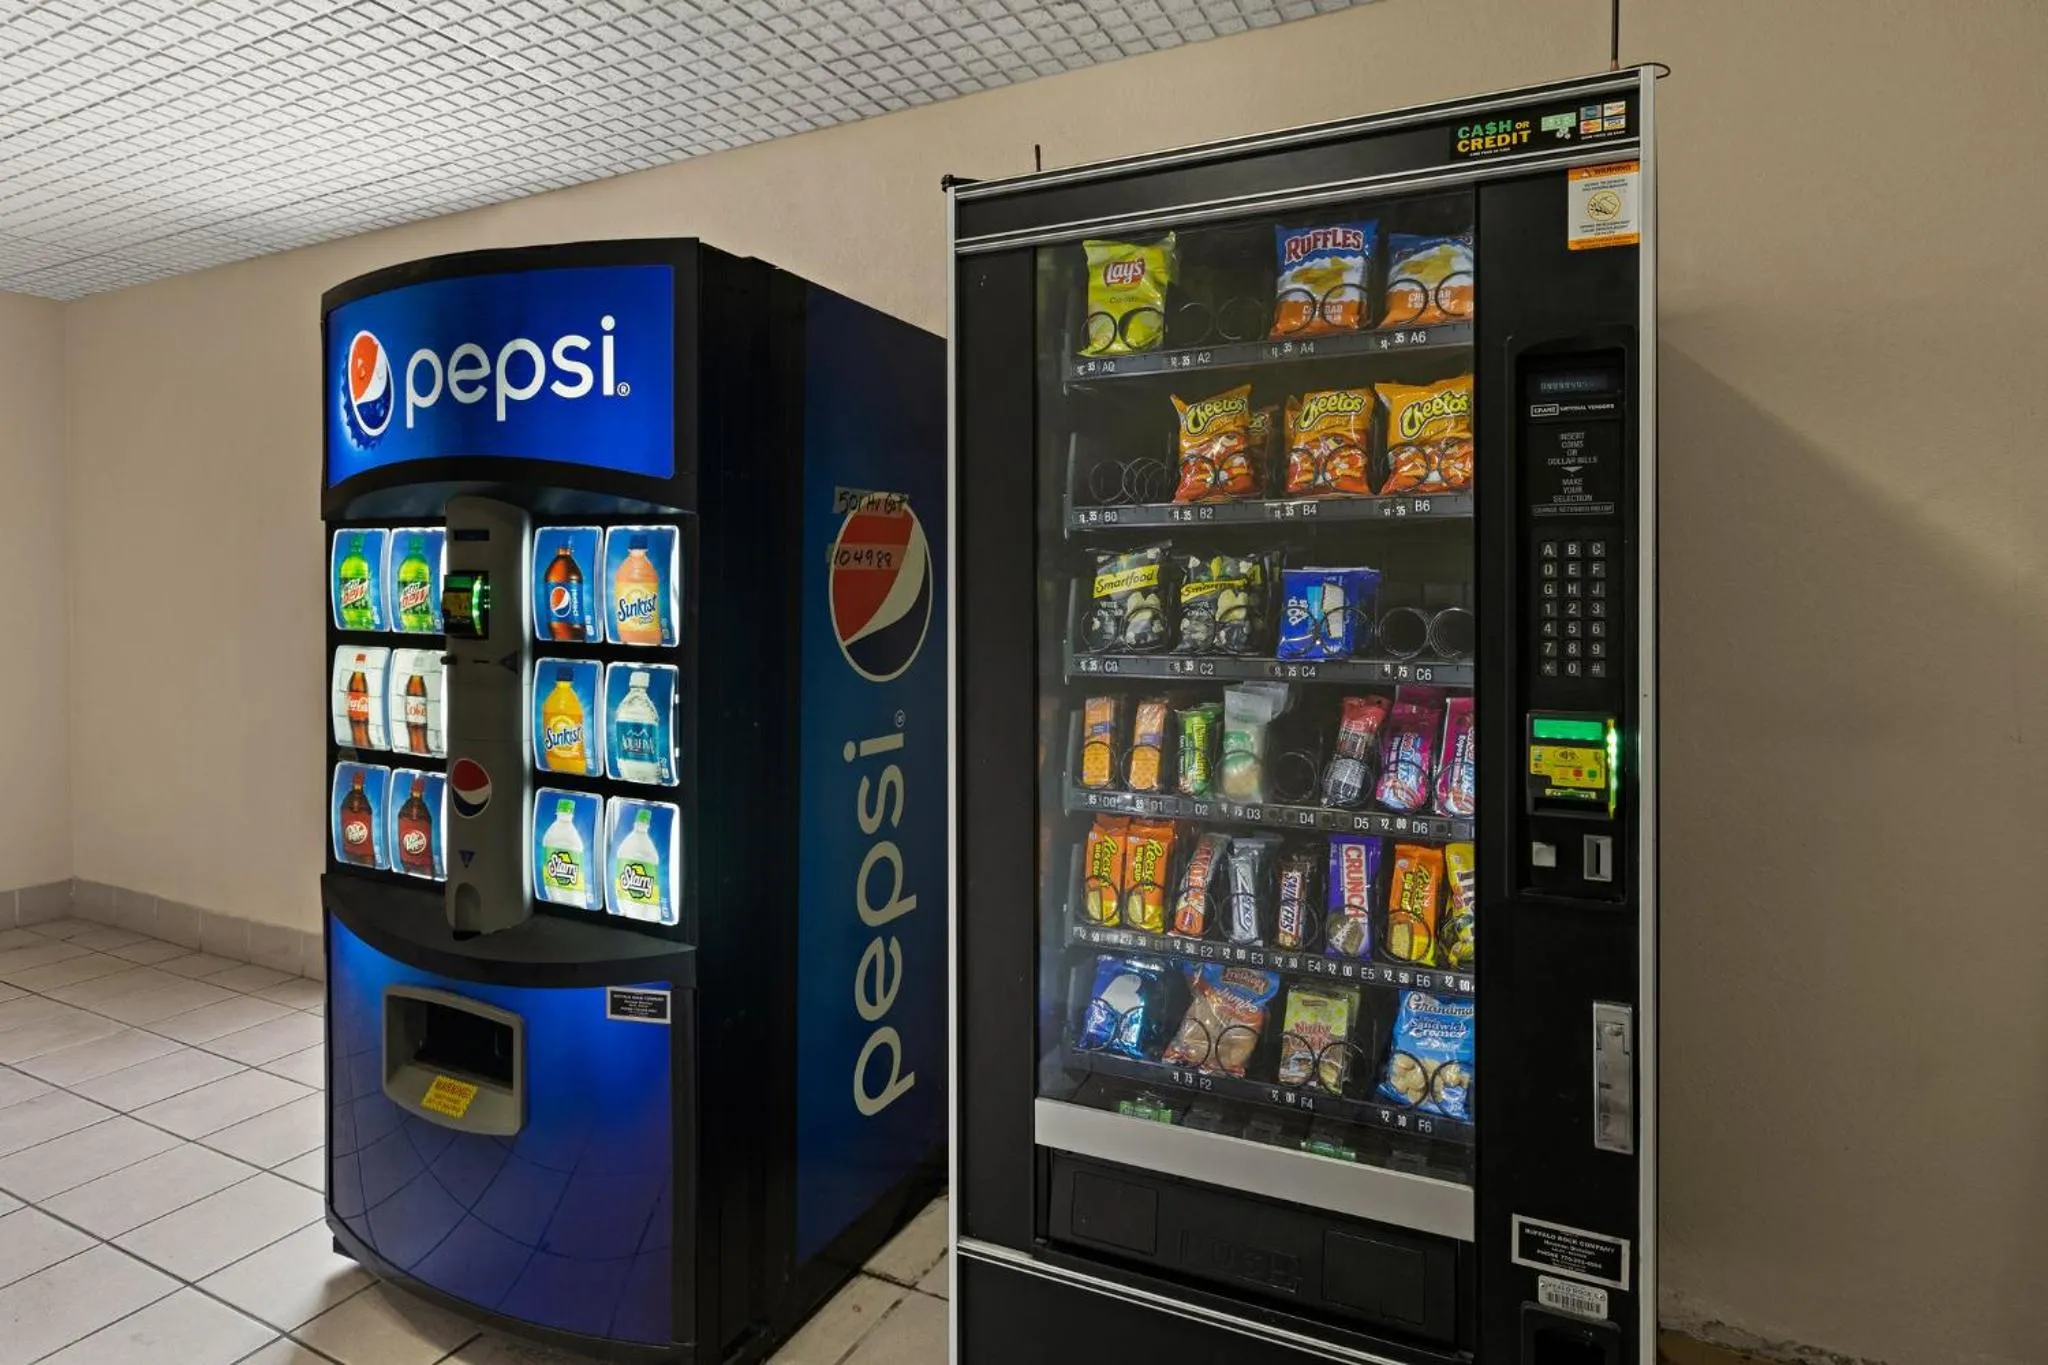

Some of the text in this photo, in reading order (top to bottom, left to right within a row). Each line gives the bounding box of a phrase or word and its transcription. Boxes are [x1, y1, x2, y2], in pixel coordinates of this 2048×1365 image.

[1515, 121, 1531, 130] OR
[1456, 130, 1532, 153] CREDIT
[1285, 228, 1364, 263] RUFFLES
[1106, 258, 1145, 284] Lay's
[1410, 331, 1426, 343] A6
[1300, 342, 1315, 354] A4
[1197, 352, 1212, 364] A2
[405, 314, 617, 430] pepsi
[1186, 397, 1248, 436] Cheetos
[1297, 392, 1366, 432] Cheetos
[1400, 389, 1471, 440] Cheetos
[1567, 449, 1578, 457] OR
[1562, 478, 1583, 486] MAKE
[1563, 486, 1583, 494] YOUR
[1553, 494, 1593, 503] SELECTION
[1303, 504, 1317, 516] B4
[1414, 499, 1431, 512] B6
[1543, 544, 1553, 555] A
[1568, 544, 1577, 555] B
[1592, 544, 1601, 555] C
[1543, 563, 1553, 575] D
[1568, 563, 1577, 575] E
[1592, 563, 1601, 575] F
[1095, 571, 1154, 594] Smartfood
[1543, 583, 1553, 595] G
[1568, 583, 1577, 595] H
[1592, 583, 1601, 595] J
[617, 593, 657, 622] Sunkist
[1545, 603, 1551, 614] 1
[1568, 603, 1577, 614] 2
[1592, 603, 1601, 614] 3
[1543, 623, 1553, 634] 4
[1568, 623, 1577, 634] 5
[1592, 623, 1601, 634] 6
[1543, 643, 1553, 655] 7
[1568, 643, 1577, 655] 8
[1592, 643, 1601, 655] 9
[1200, 663, 1214, 675] C2
[1302, 665, 1316, 677] C4
[1416, 668, 1432, 680] C6
[544, 726, 583, 750] Sunkist
[1195, 803, 1209, 816] D2
[1246, 808, 1261, 820] D3
[1300, 812, 1314, 825] D4
[1354, 817, 1369, 830] D5
[1412, 821, 1428, 834] D6
[548, 853, 579, 884] Starry
[620, 865, 653, 895] Starry
[1345, 846, 1367, 918] CRUNCH
[843, 733, 917, 1117] pepsi
[1200, 944, 1213, 957] E2
[1251, 952, 1264, 964] E3
[1307, 959, 1321, 972] E4
[1361, 967, 1375, 980] E5
[1416, 974, 1431, 987] E6
[1408, 1018, 1466, 1032] Sandwich
[1200, 1078, 1212, 1090] F2
[1301, 1097, 1313, 1110] F4
[1418, 1119, 1432, 1133] F6
[1524, 1228, 1556, 1240] BUFFALO
[1557, 1234, 1579, 1246] ROCK
[1579, 1241, 1616, 1254] COMPANY
